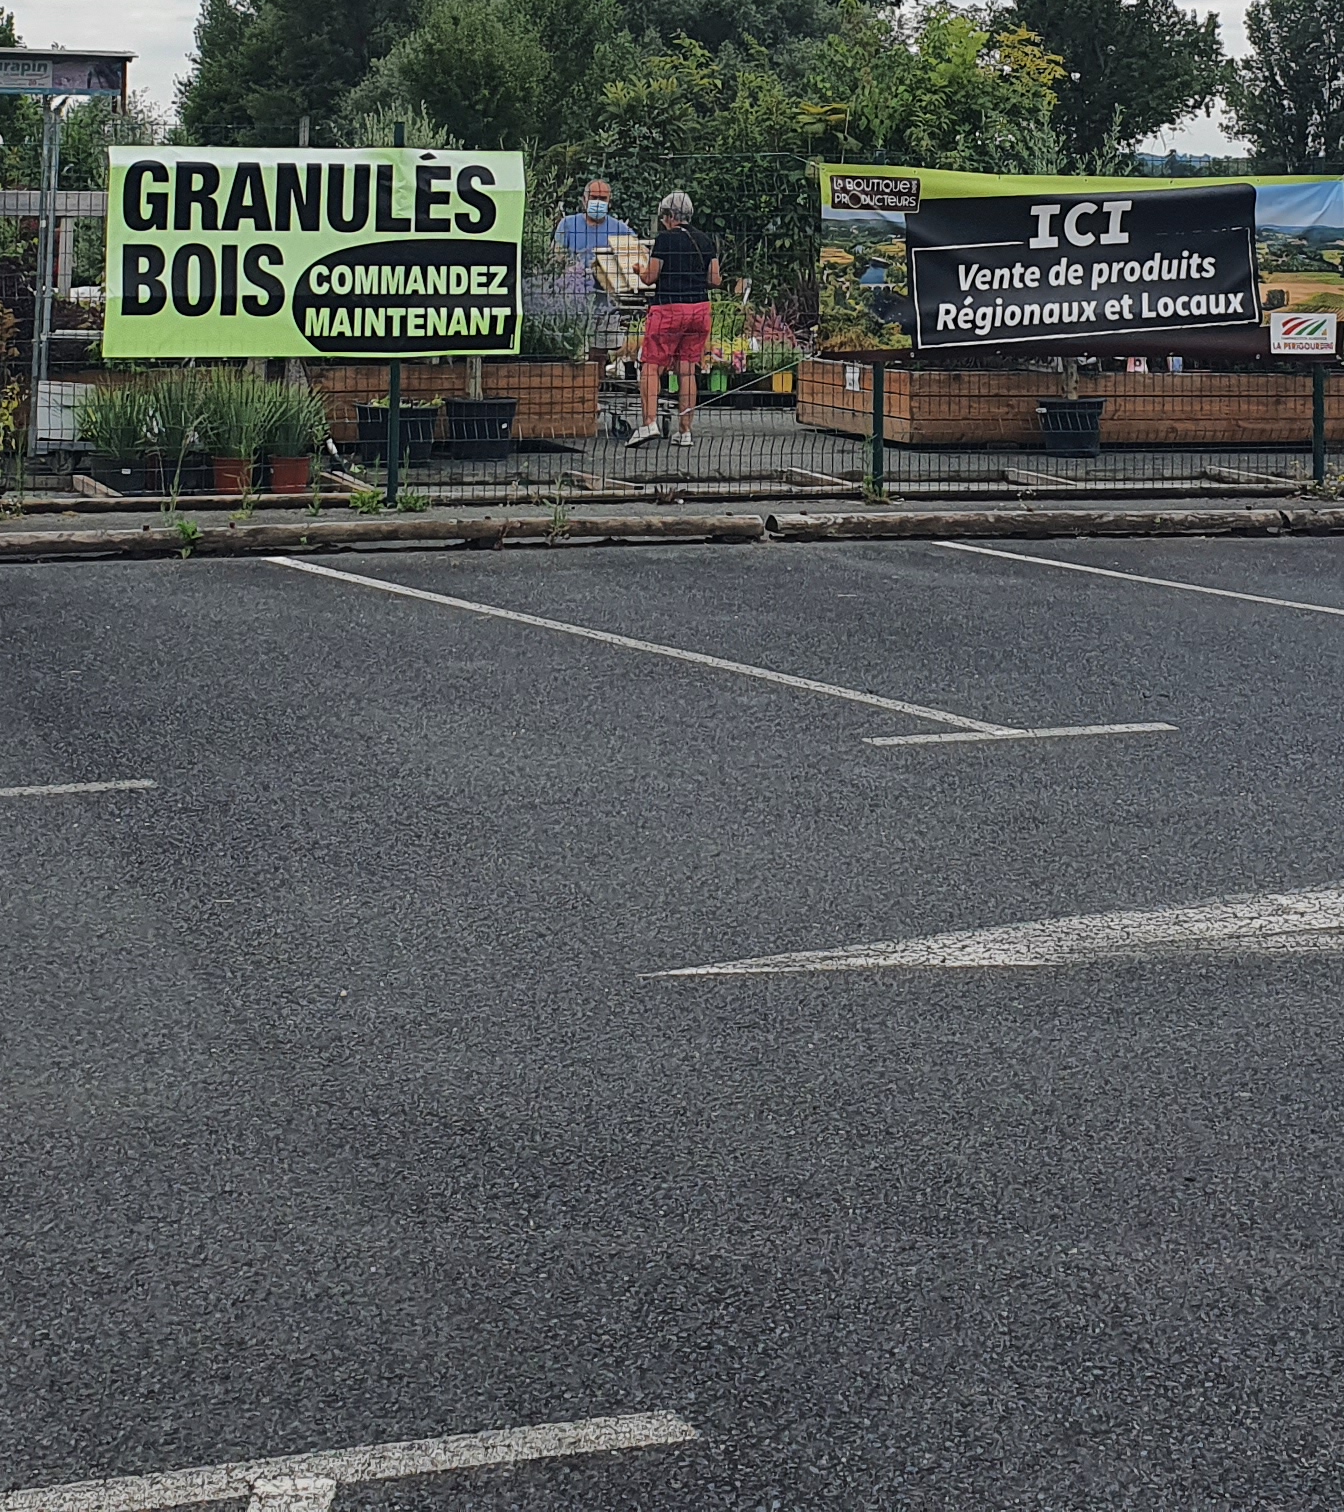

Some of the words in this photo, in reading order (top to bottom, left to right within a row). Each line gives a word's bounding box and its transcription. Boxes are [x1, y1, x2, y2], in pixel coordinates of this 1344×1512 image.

[122, 153, 497, 234] GRANULÉS
[1028, 200, 1133, 250] ICI
[121, 243, 285, 317] BOIS
[309, 265, 508, 295] COMMANDEZ
[957, 261, 1041, 292] Vente
[1048, 255, 1085, 287] de
[1090, 249, 1216, 291] produits
[305, 307, 511, 337] MAINTENANT
[936, 295, 1098, 336] Régionaux
[1105, 293, 1134, 321] et
[1141, 291, 1244, 320] Locaux
